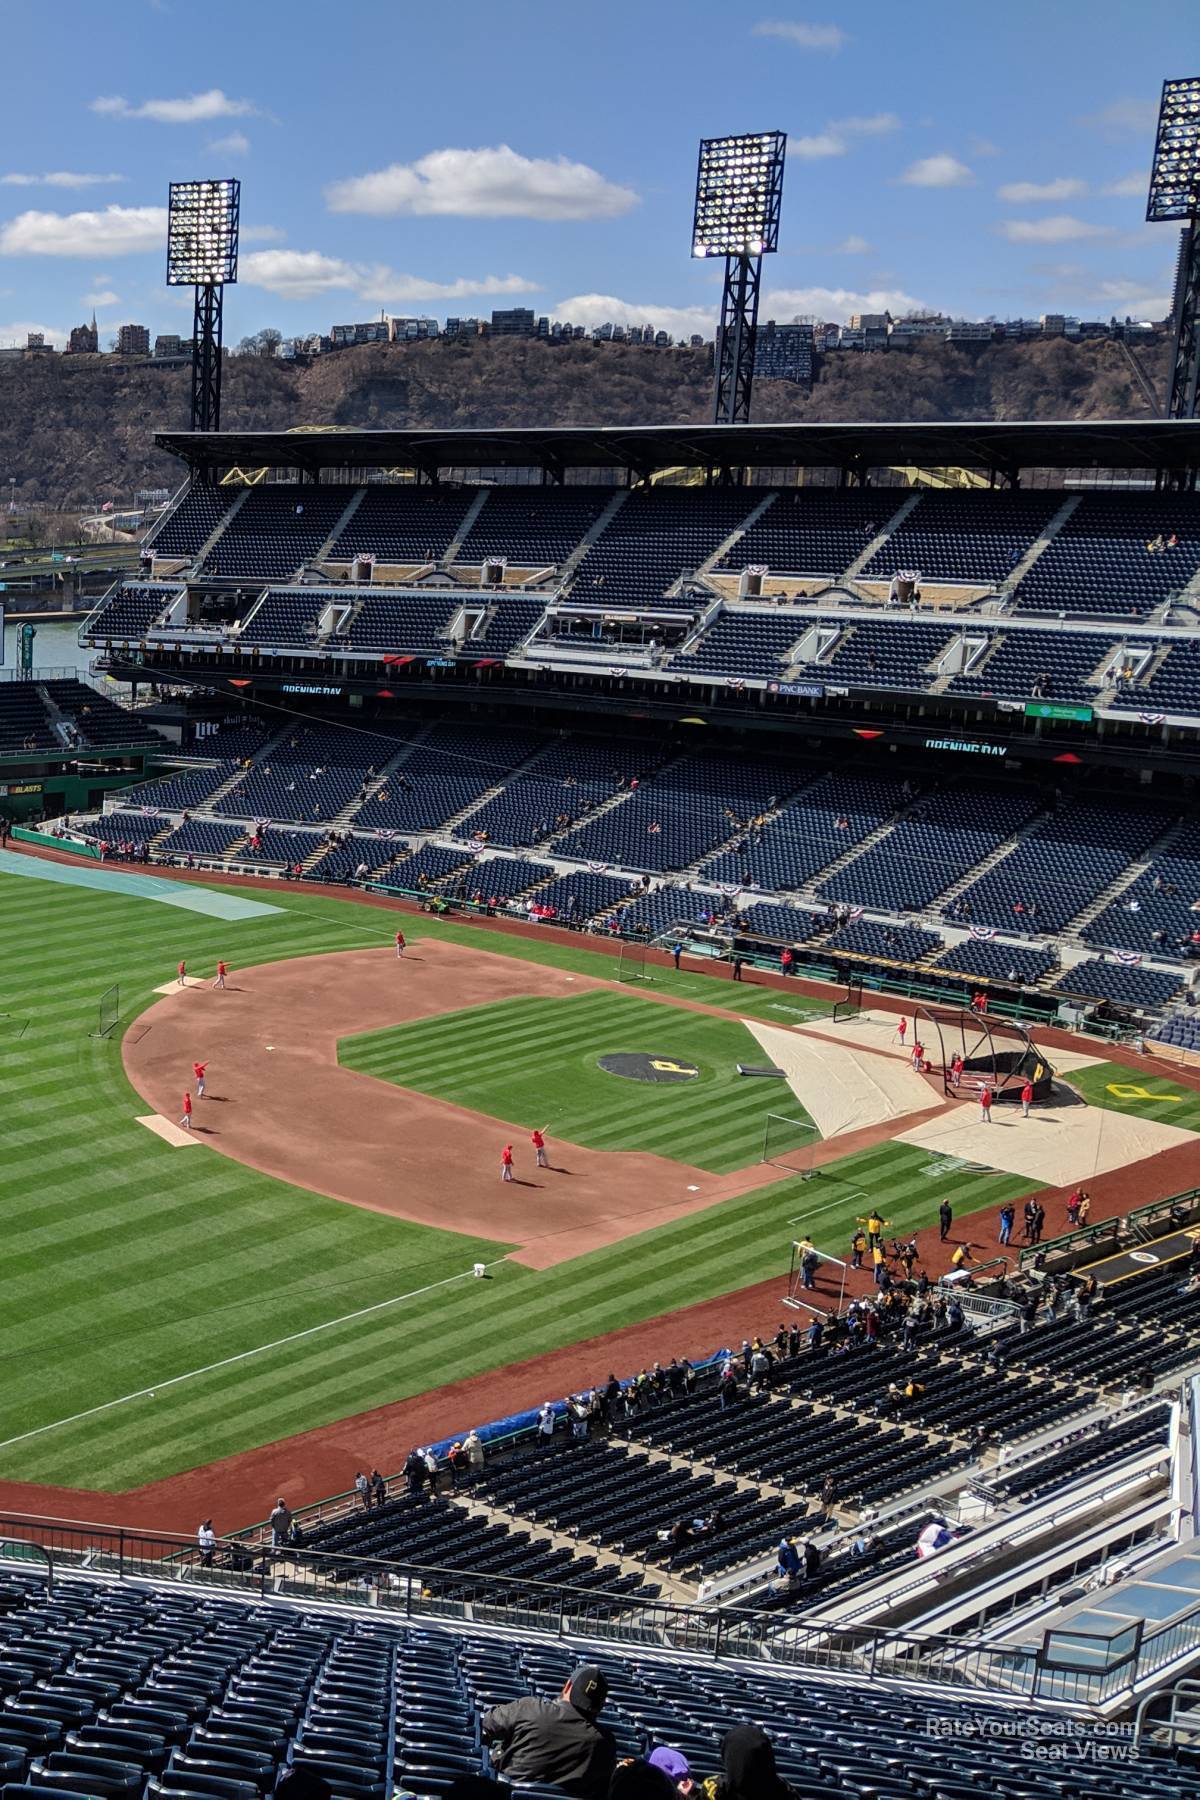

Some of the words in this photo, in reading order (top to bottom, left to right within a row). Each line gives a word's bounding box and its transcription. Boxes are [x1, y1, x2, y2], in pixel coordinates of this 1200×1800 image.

[779, 685, 798, 693] PNC
[798, 686, 820, 695] BANK
[195, 721, 220, 740] Lite
[15, 784, 42, 793] BLASTS
